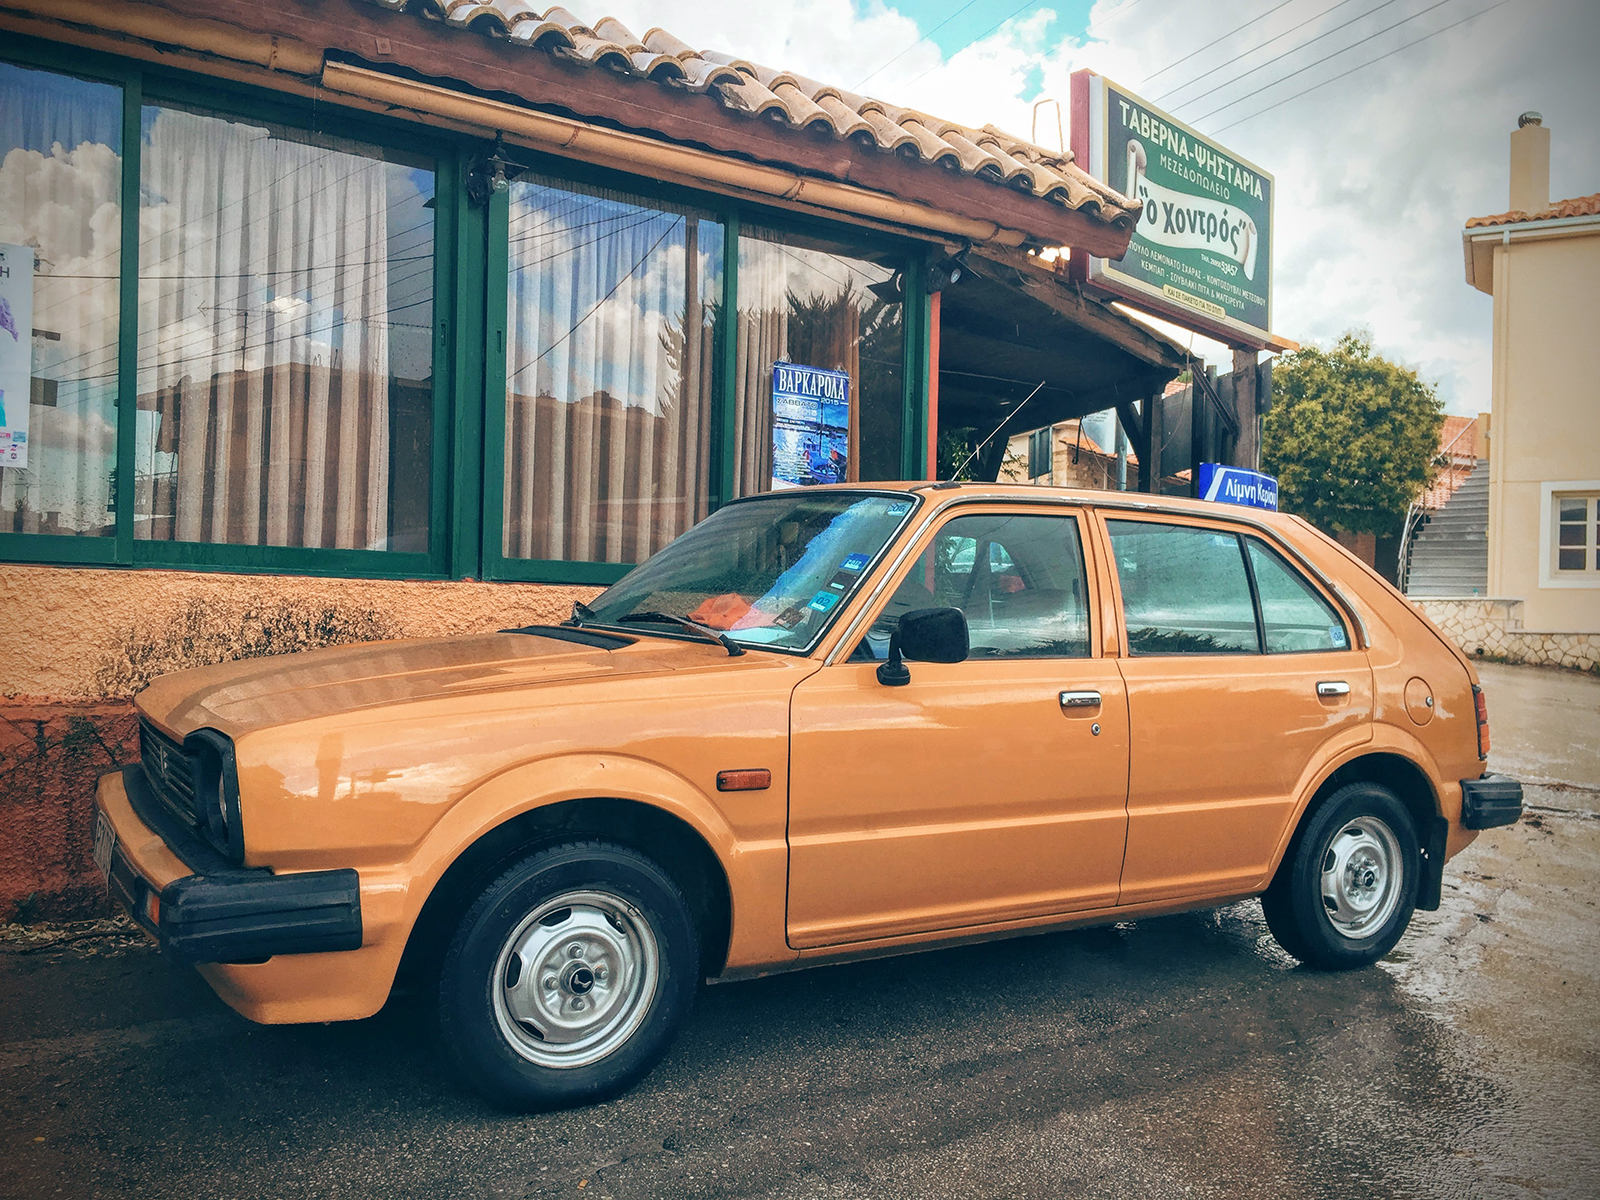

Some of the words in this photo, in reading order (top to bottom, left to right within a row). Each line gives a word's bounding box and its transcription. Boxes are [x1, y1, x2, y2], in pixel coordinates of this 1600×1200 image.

[1119, 99, 1263, 201] ΤΑΒΕΡΝΑ-ΨΗΣΤΑΡΙΑ
[1160, 153, 1230, 200] ΜΕΖΕΔΟΠΩΛΕΙΟ
[1127, 240, 1149, 257] ΠΟΥΛΟ
[1150, 250, 1181, 270] ΛΕΜΟΝΑΤΟ
[1181, 263, 1202, 280] ΣΧΑΡΑΣ
[1141, 259, 1165, 278] ΚΕΜΠΑΠ
[1170, 271, 1197, 291] ΣΟΥΒΛΑΚΙ
[779, 369, 845, 400] ΒΑΡΚΑΡΟΛΑ
[1225, 478, 1256, 504] Λίμνη
